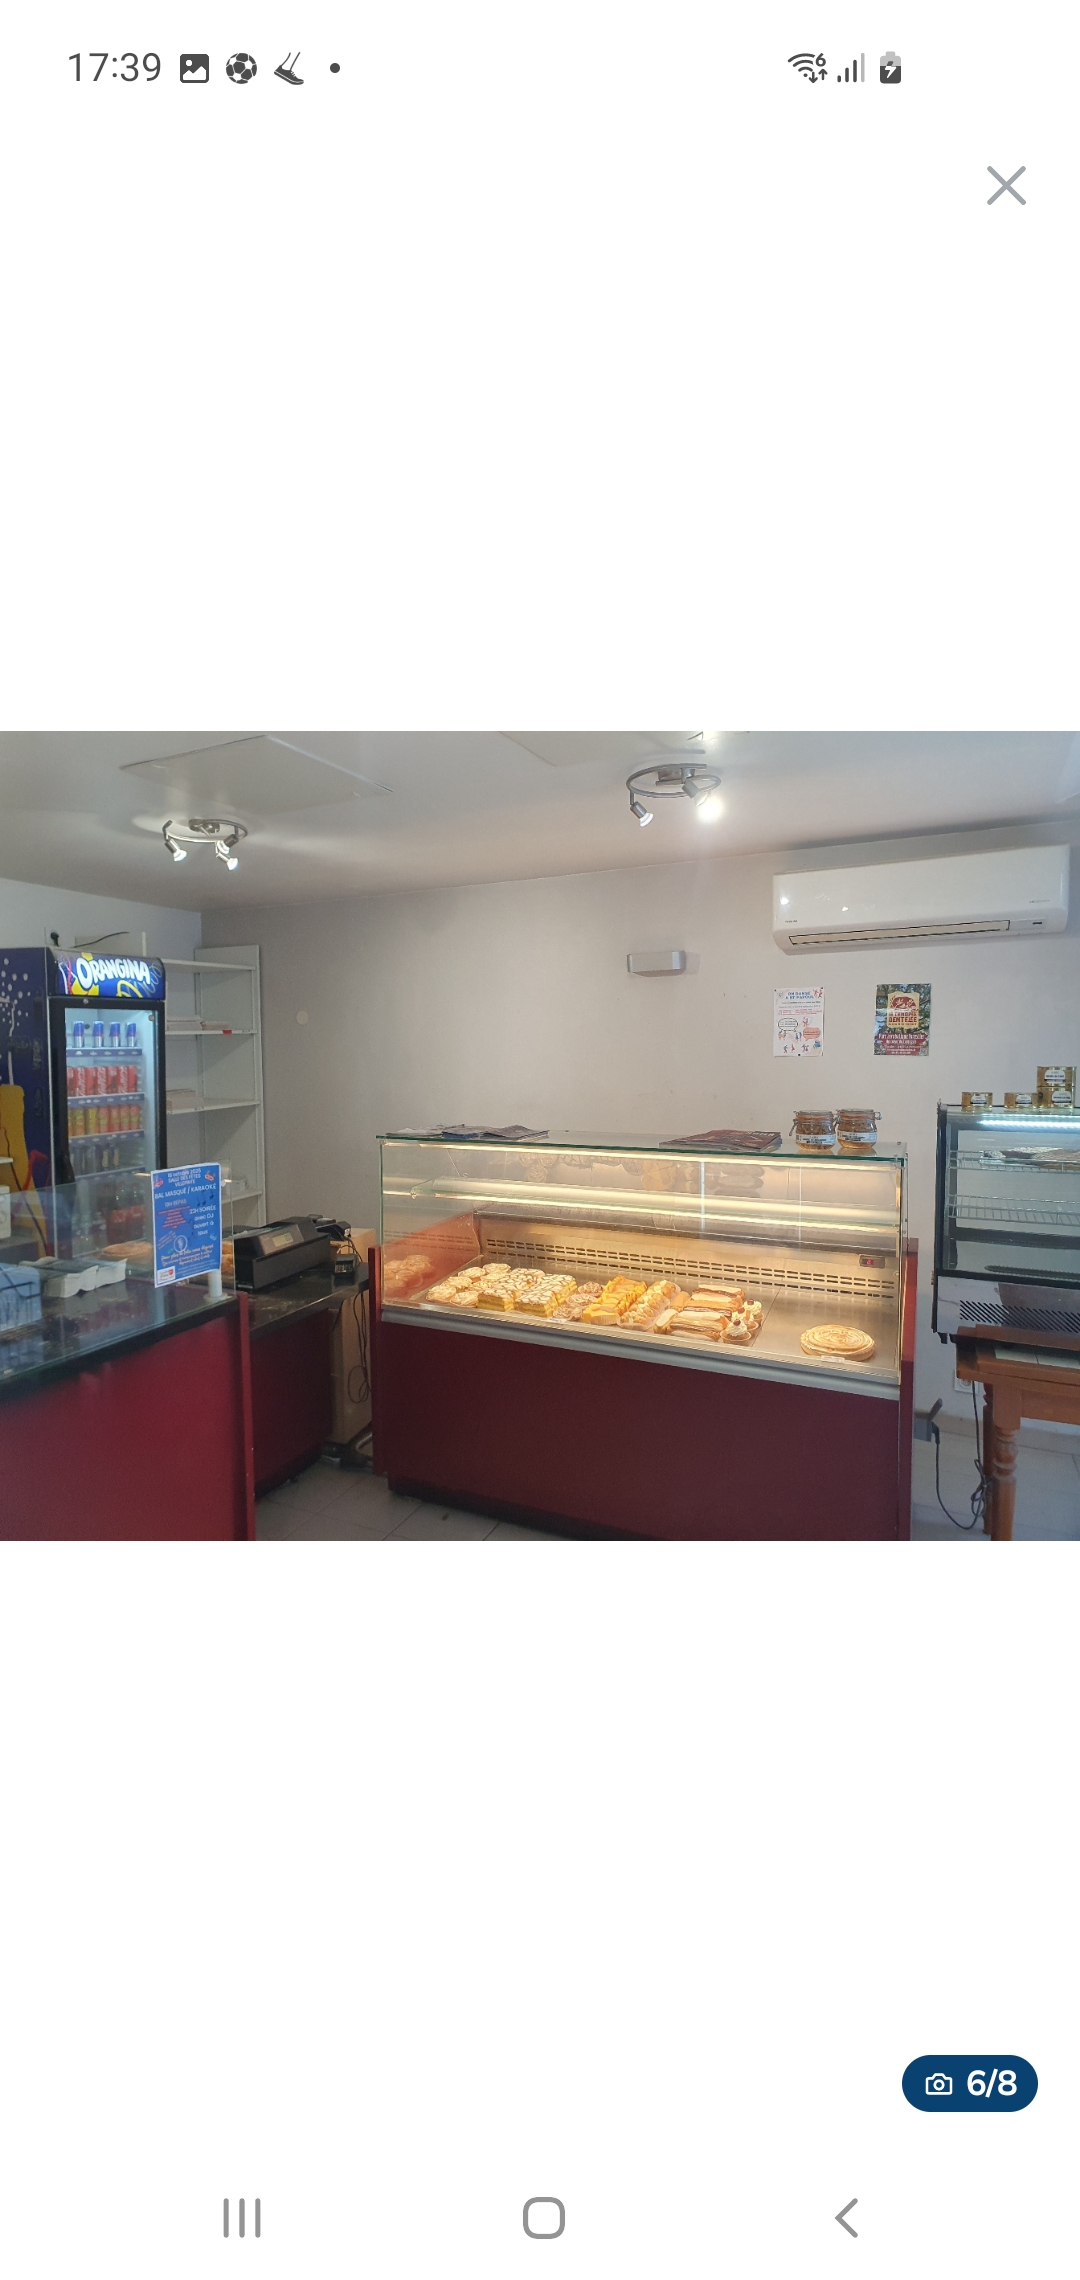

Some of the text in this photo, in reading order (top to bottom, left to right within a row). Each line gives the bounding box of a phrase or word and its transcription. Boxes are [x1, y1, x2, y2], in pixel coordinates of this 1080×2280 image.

[76, 957, 151, 990] ORANGINA
[165, 1187, 186, 1198] MASQUÉ
[191, 1183, 216, 1192] KARAOKÉ
